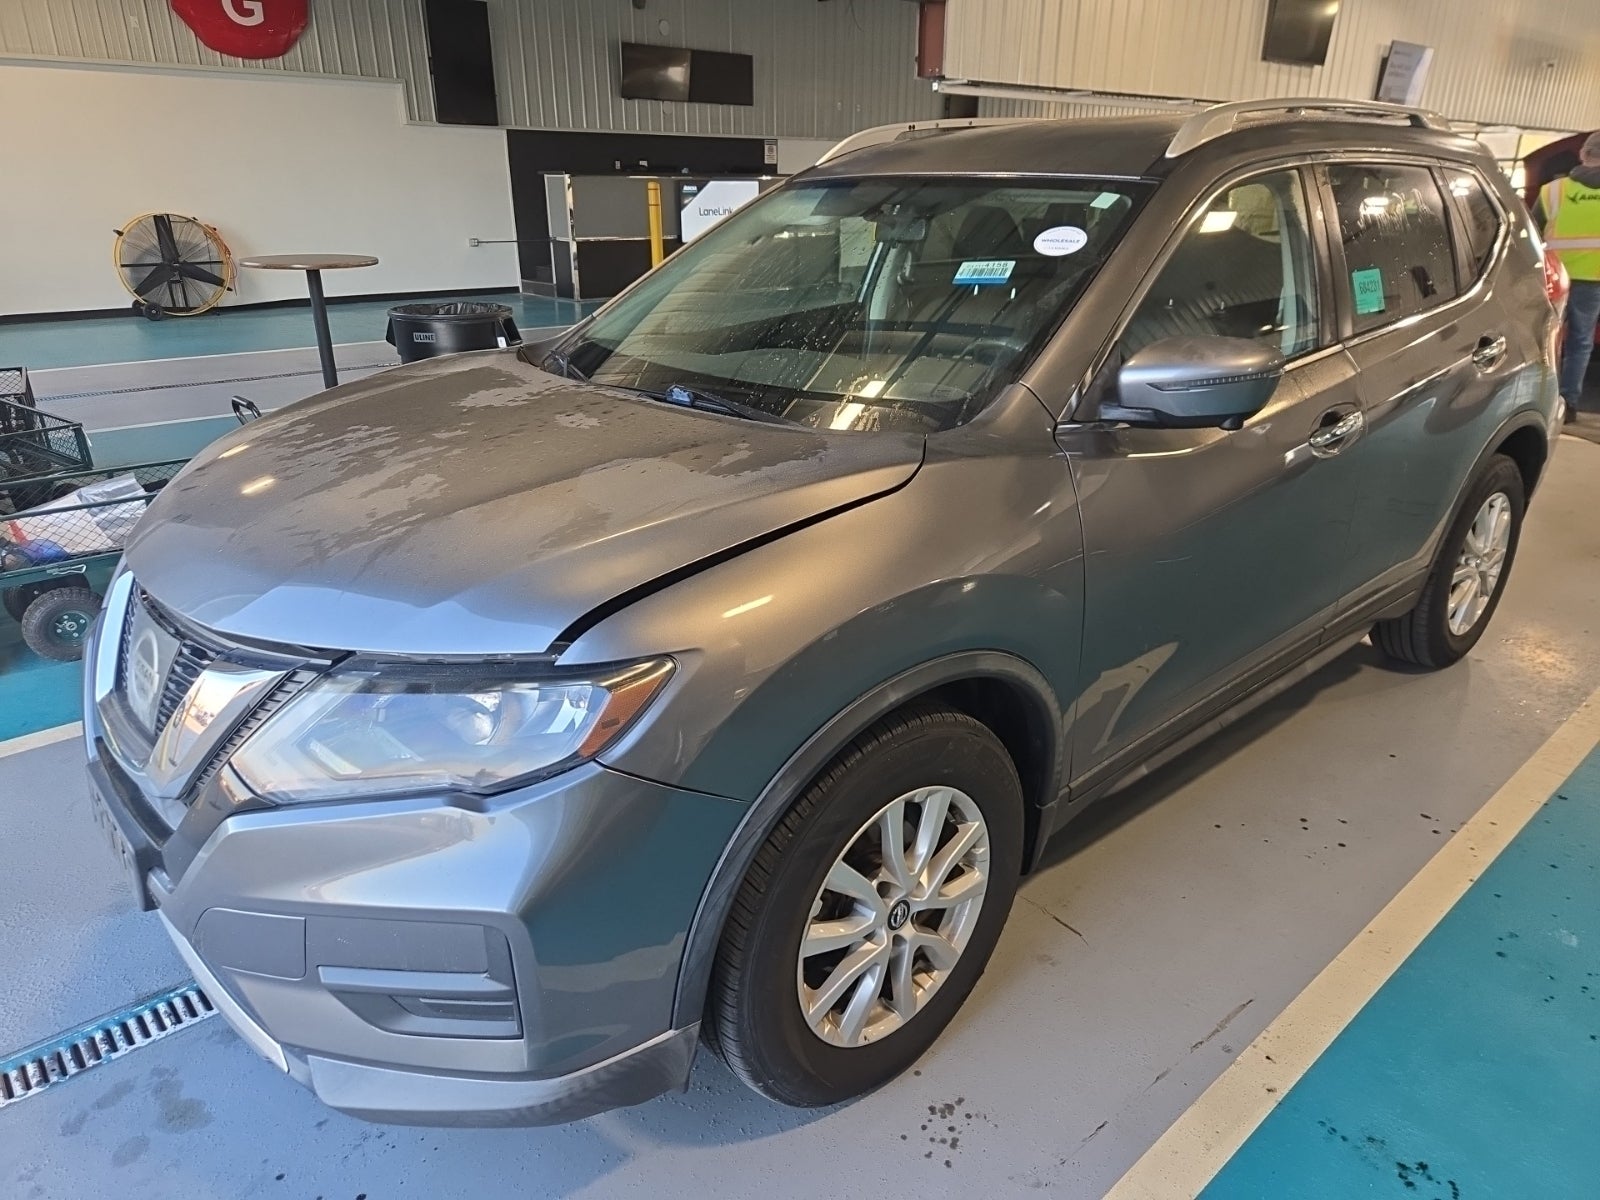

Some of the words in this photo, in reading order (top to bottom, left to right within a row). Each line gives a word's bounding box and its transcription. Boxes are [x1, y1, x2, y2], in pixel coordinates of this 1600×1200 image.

[222, 0, 264, 26] G
[699, 206, 733, 216] LaneLink
[414, 333, 435, 341] ULINE
